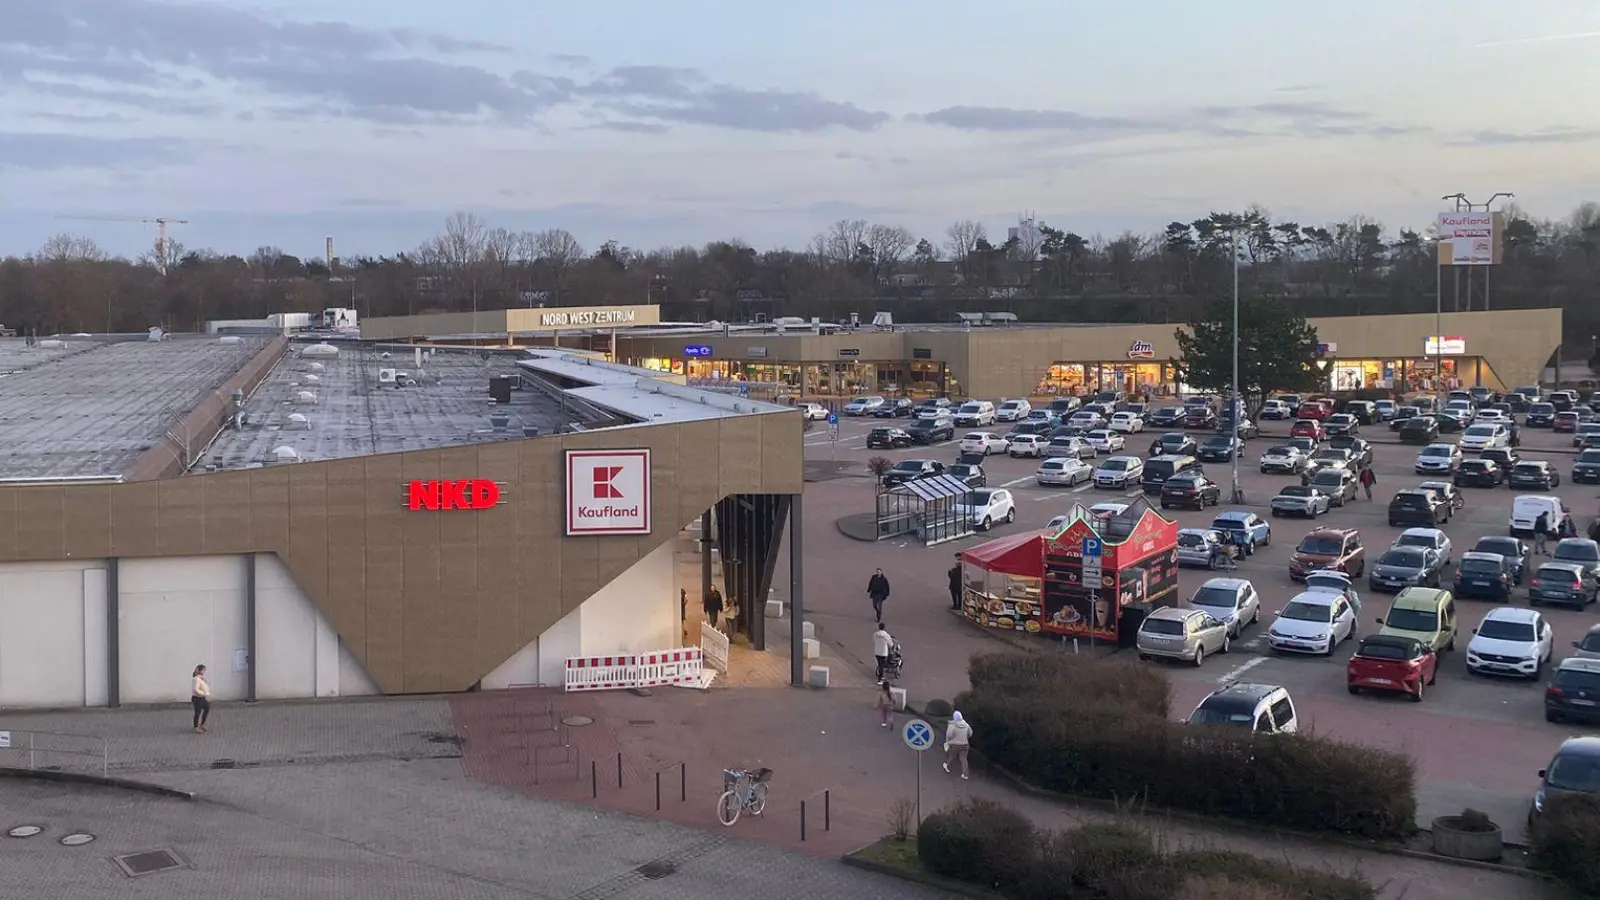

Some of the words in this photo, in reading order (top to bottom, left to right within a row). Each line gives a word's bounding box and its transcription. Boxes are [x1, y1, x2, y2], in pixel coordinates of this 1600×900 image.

[542, 313, 568, 326] NORD
[570, 311, 593, 325] WEST
[595, 310, 635, 323] ZENTRUM
[1134, 340, 1151, 352] dm
[409, 478, 500, 511] NKD
[578, 505, 638, 518] Kaufland
[1087, 539, 1098, 553] P
